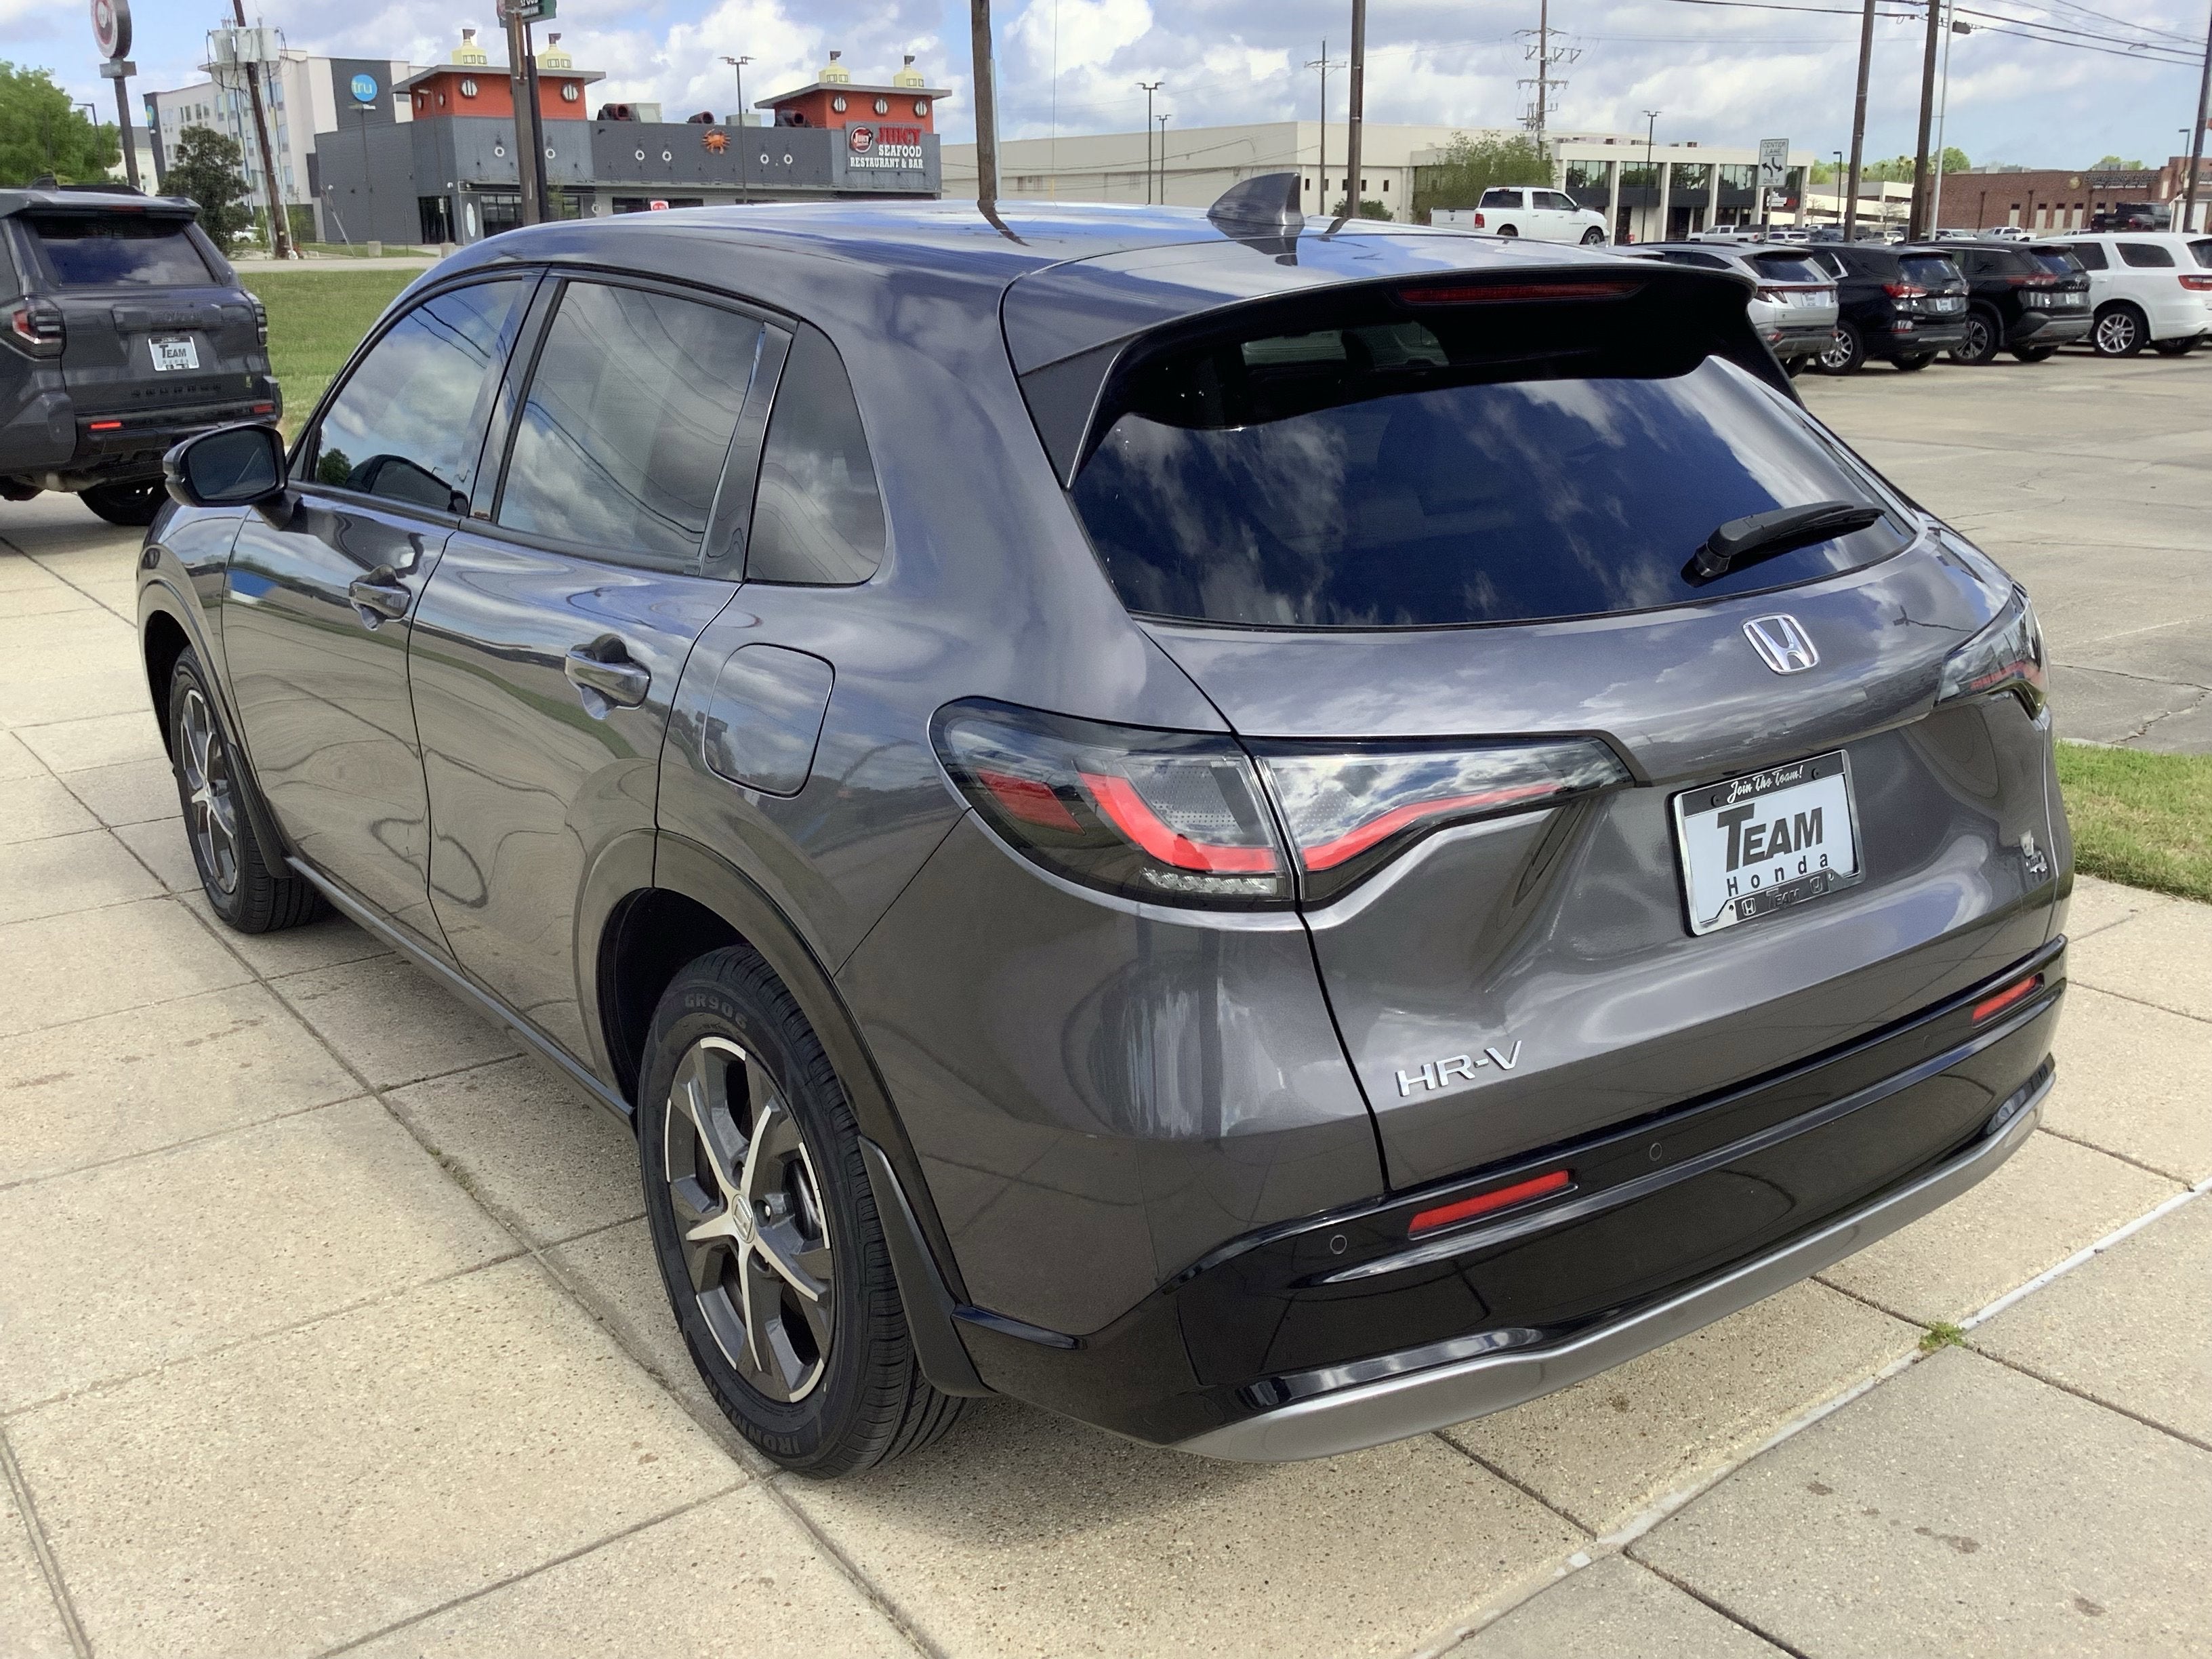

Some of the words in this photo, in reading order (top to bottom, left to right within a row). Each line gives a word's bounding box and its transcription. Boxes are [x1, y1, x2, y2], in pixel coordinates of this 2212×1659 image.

[876, 127, 922, 145] JUICY
[878, 144, 922, 157] SEAFOOD
[850, 157, 899, 169] RESTAURANT
[901, 158, 907, 169] &
[908, 158, 924, 169] BAR
[1727, 781, 1753, 804] Join
[1752, 774, 1773, 792] The
[1771, 764, 1804, 786] Team!
[1726, 853, 1828, 897] Honda
[1395, 1040, 1522, 1097] HR-V
